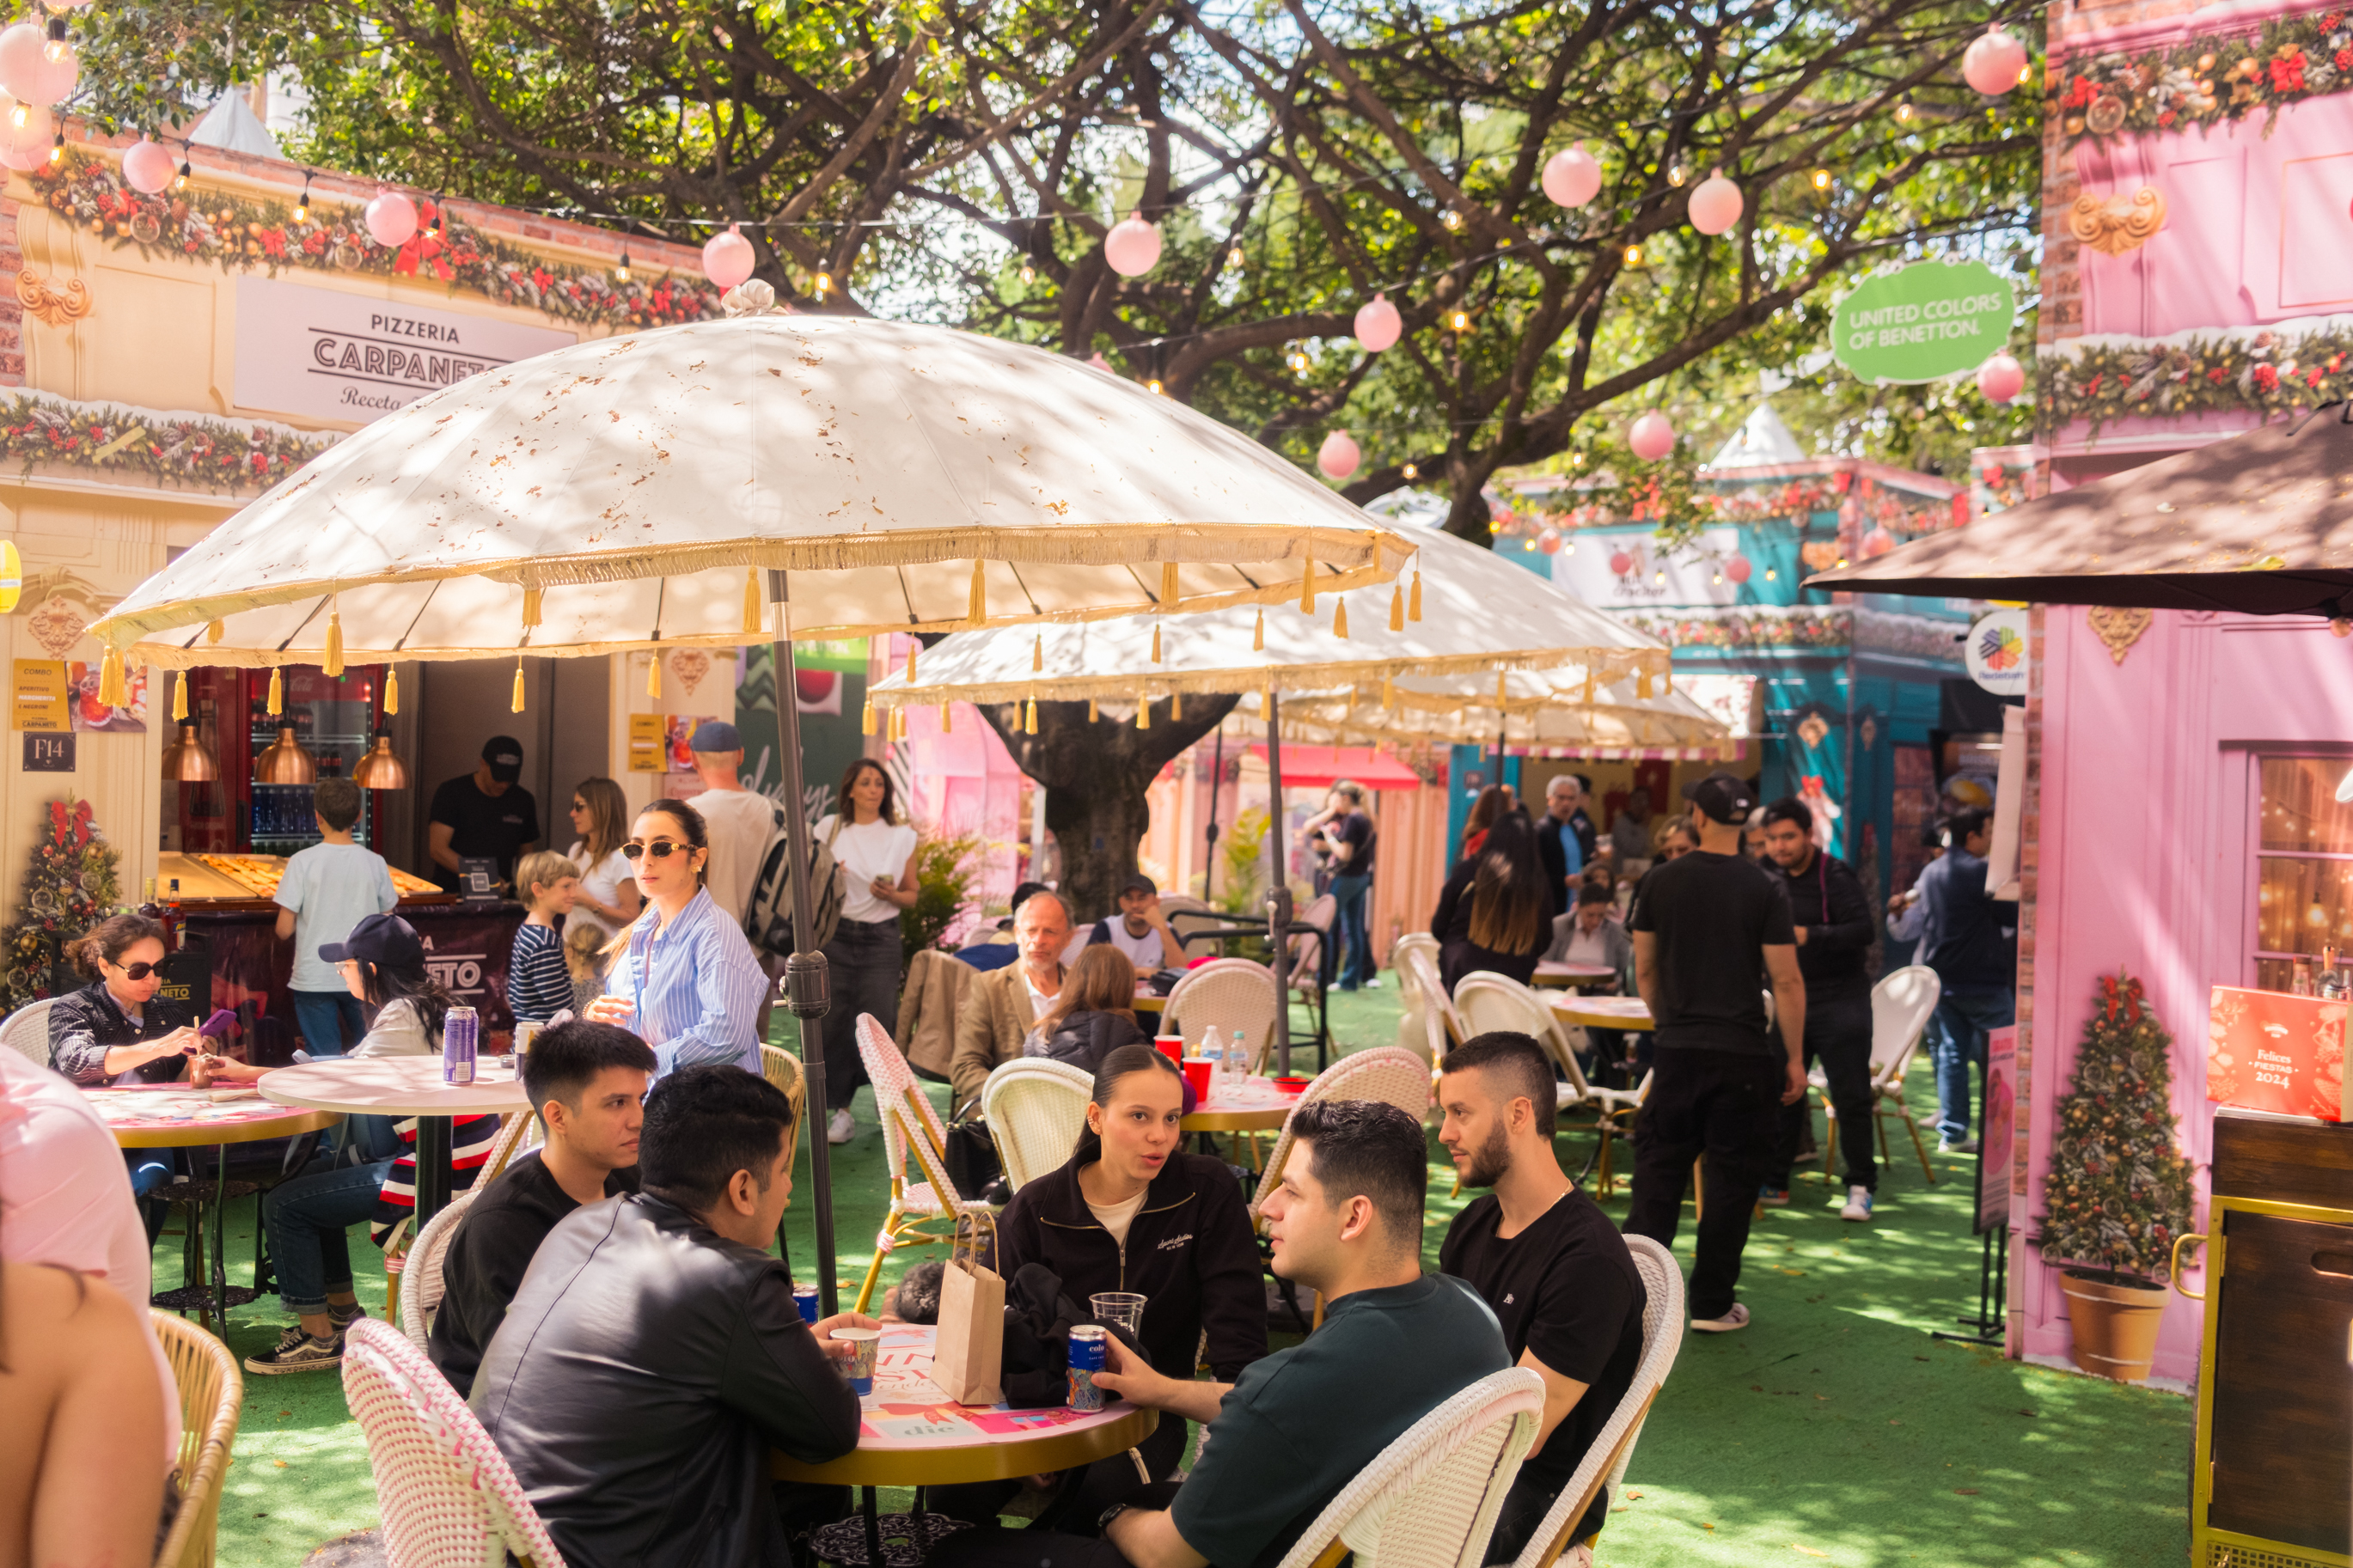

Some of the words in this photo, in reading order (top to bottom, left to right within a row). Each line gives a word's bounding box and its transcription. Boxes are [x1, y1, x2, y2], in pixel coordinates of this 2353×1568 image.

[1849, 303, 1921, 329] UNITED
[1923, 291, 2002, 320] COLORS
[371, 314, 460, 344] PIZZERIA
[1849, 330, 1875, 351] OF
[1879, 319, 1982, 347] BENETTON.
[314, 338, 502, 385] CARPANET
[340, 386, 401, 412] Receta
[34, 738, 64, 760] F14
[2254, 1061, 2293, 1074] FIESTAS
[2257, 1049, 2292, 1065] Felices
[2255, 1071, 2290, 1089] 2024
[1089, 1344, 1104, 1353] colo
